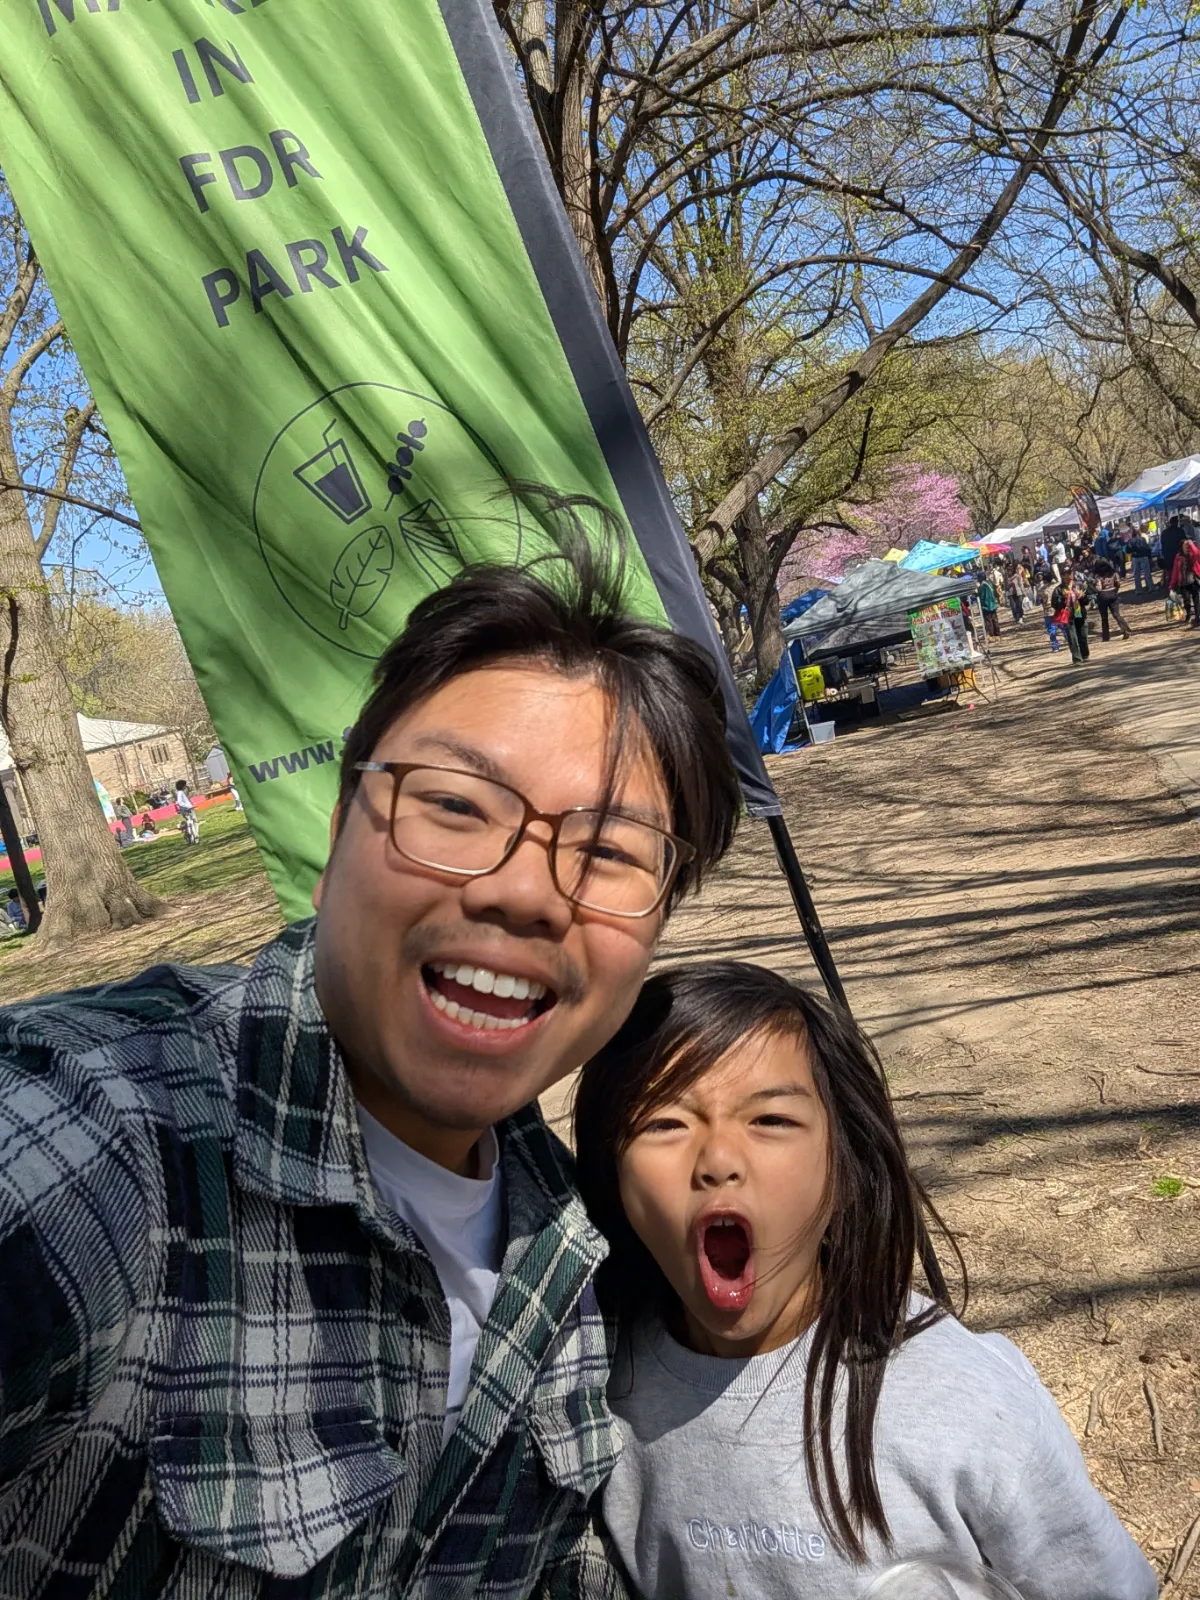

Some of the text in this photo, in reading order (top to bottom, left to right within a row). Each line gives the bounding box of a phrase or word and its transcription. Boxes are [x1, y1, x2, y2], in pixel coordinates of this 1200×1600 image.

[172, 37, 255, 104] IN
[179, 129, 324, 214] FDR
[201, 225, 389, 328] PARK
[688, 1517, 825, 1559] Charlotte
